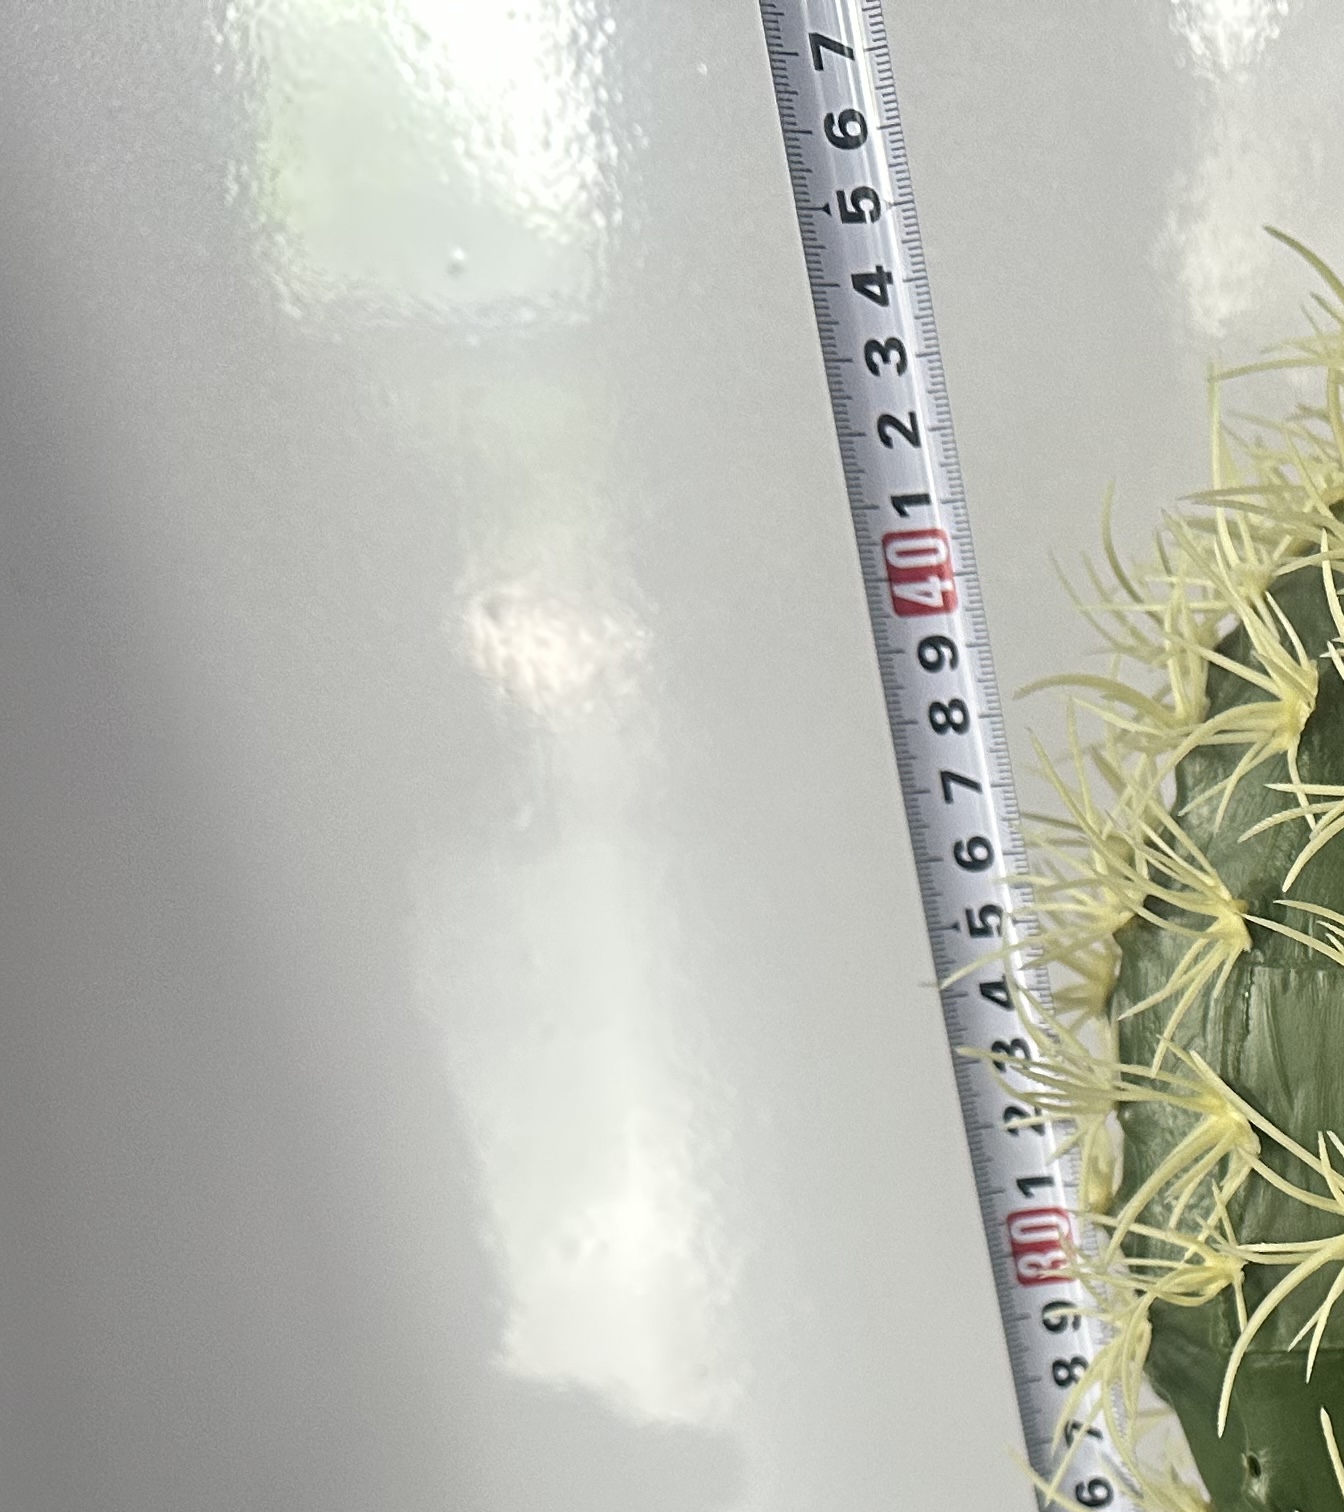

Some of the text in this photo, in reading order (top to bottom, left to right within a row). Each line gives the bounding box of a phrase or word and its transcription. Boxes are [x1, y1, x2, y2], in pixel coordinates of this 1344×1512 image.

[809, 33, 855, 70] 7
[824, 108, 868, 150] 6
[836, 186, 881, 224] 5
[851, 265, 893, 307] 4
[864, 337, 908, 377] 3
[877, 411, 921, 449] 2
[890, 493, 931, 518] 1
[885, 537, 954, 607] 40
[917, 635, 959, 673] 9
[928, 698, 970, 735] 8
[939, 771, 983, 804] 7
[953, 836, 995, 872] 6
[965, 904, 1003, 939] 5
[1016, 1175, 1055, 1198] 1
[1052, 1355, 1089, 1387] 8
[1075, 1476, 1114, 1509] 6
